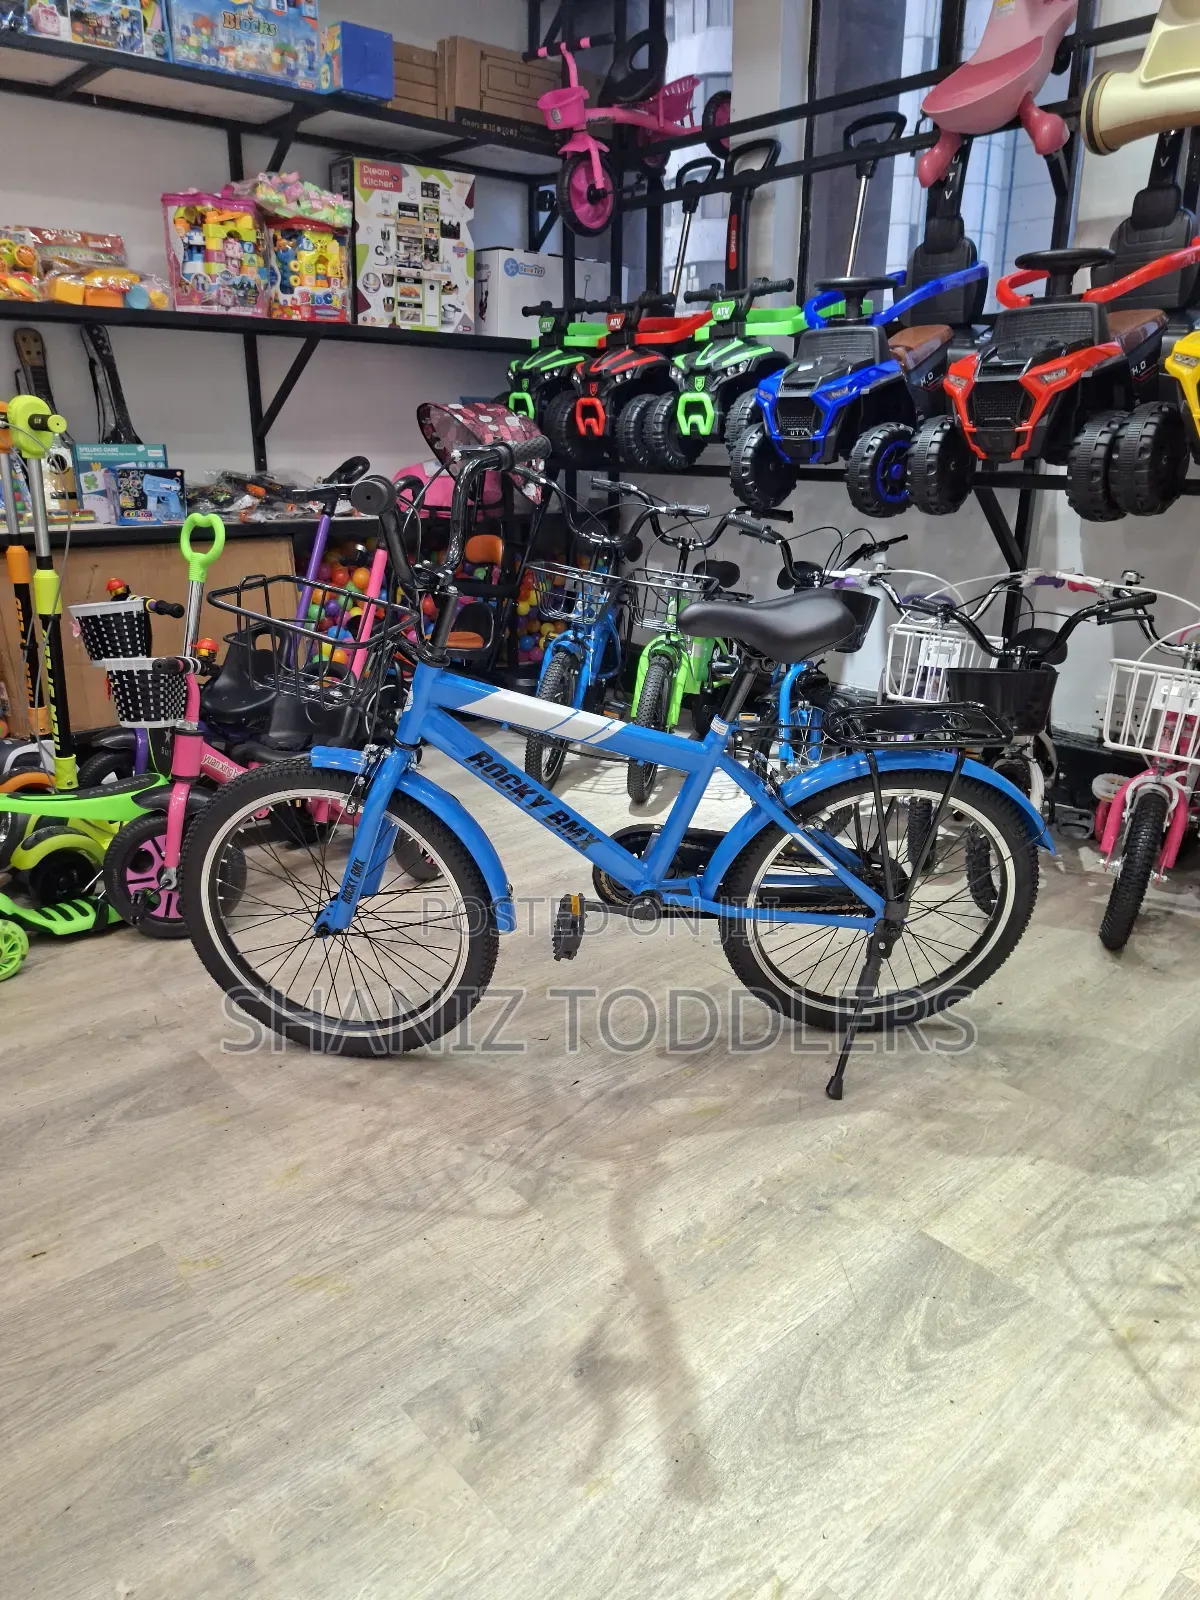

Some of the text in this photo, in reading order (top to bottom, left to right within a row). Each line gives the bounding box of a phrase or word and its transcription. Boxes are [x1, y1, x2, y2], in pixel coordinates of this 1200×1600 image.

[222, 10, 277, 37] Blocks
[363, 165, 390, 177] Dream
[363, 176, 394, 189] Kitchen
[716, 306, 730, 316] ATV
[541, 321, 552, 329] ATV
[609, 317, 621, 327] ATV
[201, 754, 221, 770] yuan
[220, 763, 234, 777] xing
[464, 750, 603, 851] ROCKY BMX
[341, 857, 366, 904] ROCKY BMX
